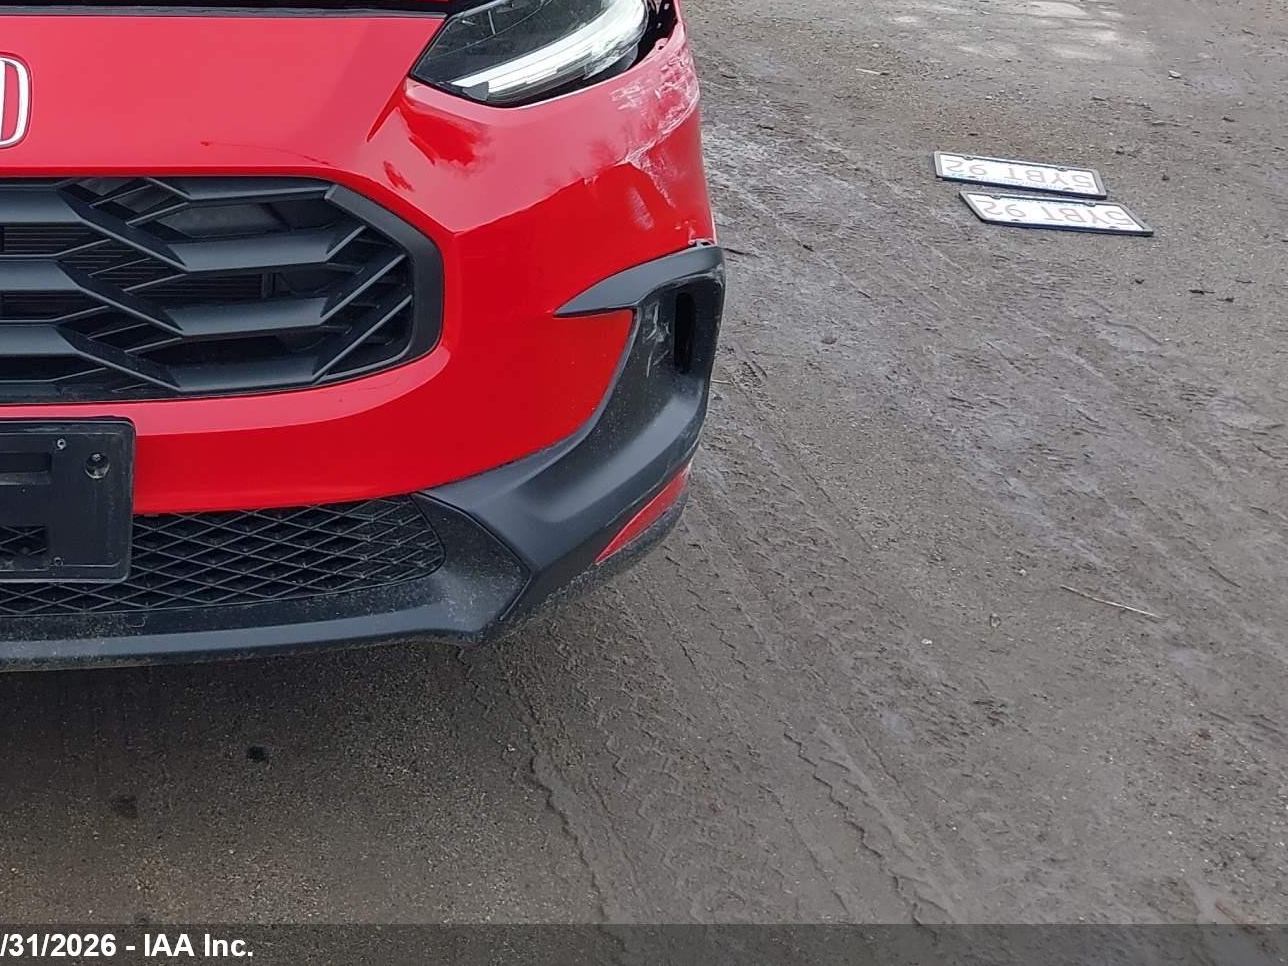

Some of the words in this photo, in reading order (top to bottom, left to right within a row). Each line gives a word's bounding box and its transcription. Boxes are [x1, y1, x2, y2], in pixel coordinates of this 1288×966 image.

[945, 160, 988, 176] 92
[1009, 168, 1093, 188] 5YBT
[976, 200, 1027, 218] 92
[1041, 207, 1134, 226] 5YBT
